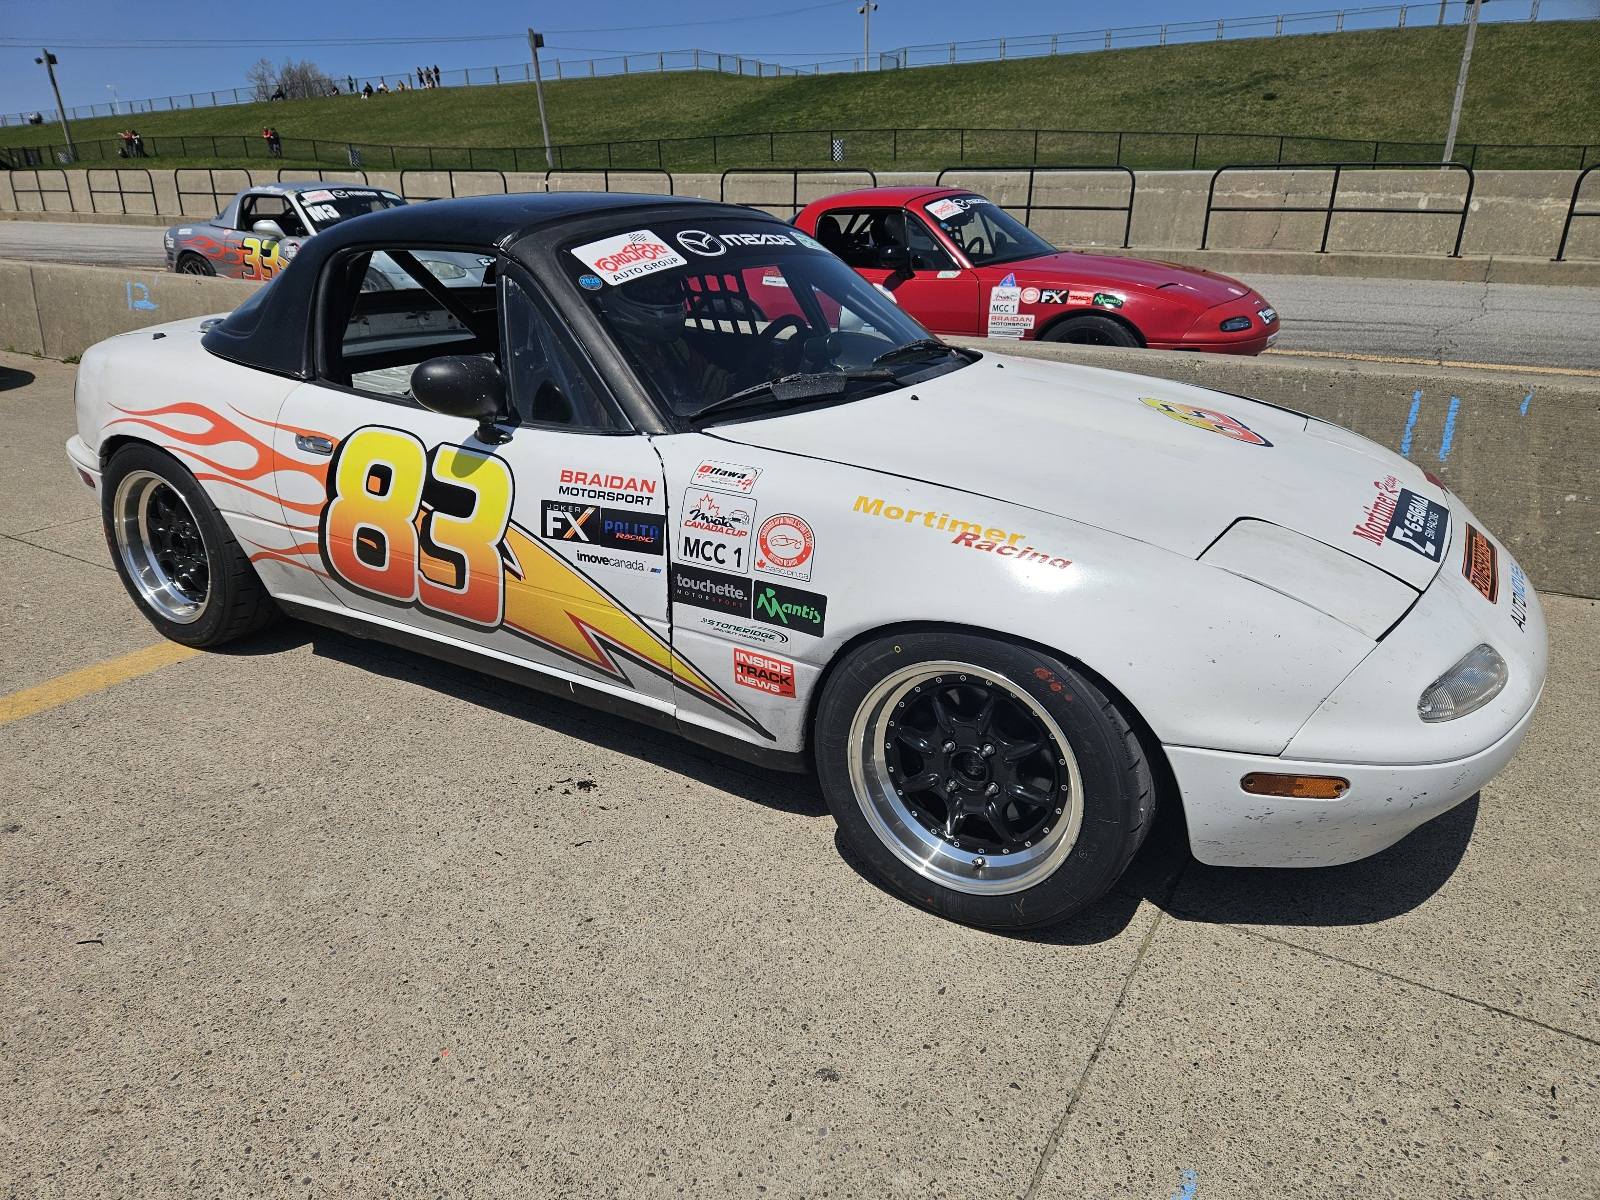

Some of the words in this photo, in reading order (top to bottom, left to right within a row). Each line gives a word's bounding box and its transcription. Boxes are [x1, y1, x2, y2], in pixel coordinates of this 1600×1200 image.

[305, 203, 341, 222] M3
[613, 267, 643, 282] AUTO
[643, 257, 679, 272] GROUP
[1041, 290, 1068, 304] FX
[991, 315, 1033, 323] BRAIDAN
[992, 304, 1009, 313] MCC
[559, 469, 657, 494] BRAIDAN
[698, 465, 748, 480] Ottawa
[558, 485, 654, 506] MOTORSPORT
[546, 503, 581, 513] JOKER
[319, 424, 515, 633] 83
[546, 507, 597, 542] FX
[684, 519, 724, 534] CANADA
[724, 528, 748, 538] CUP
[690, 509, 736, 530] Miata
[852, 495, 1026, 546] Mortimer
[1353, 493, 1399, 547] Mortimer
[577, 549, 645, 572] imovecanada
[683, 536, 727, 565] MCC
[733, 547, 743, 568] 1
[757, 587, 821, 625] Mantis
[707, 619, 777, 641] STONERIDGE
[735, 651, 792, 676] INSIDE
[736, 662, 793, 687] TRACK
[736, 673, 781, 693] NEWS
